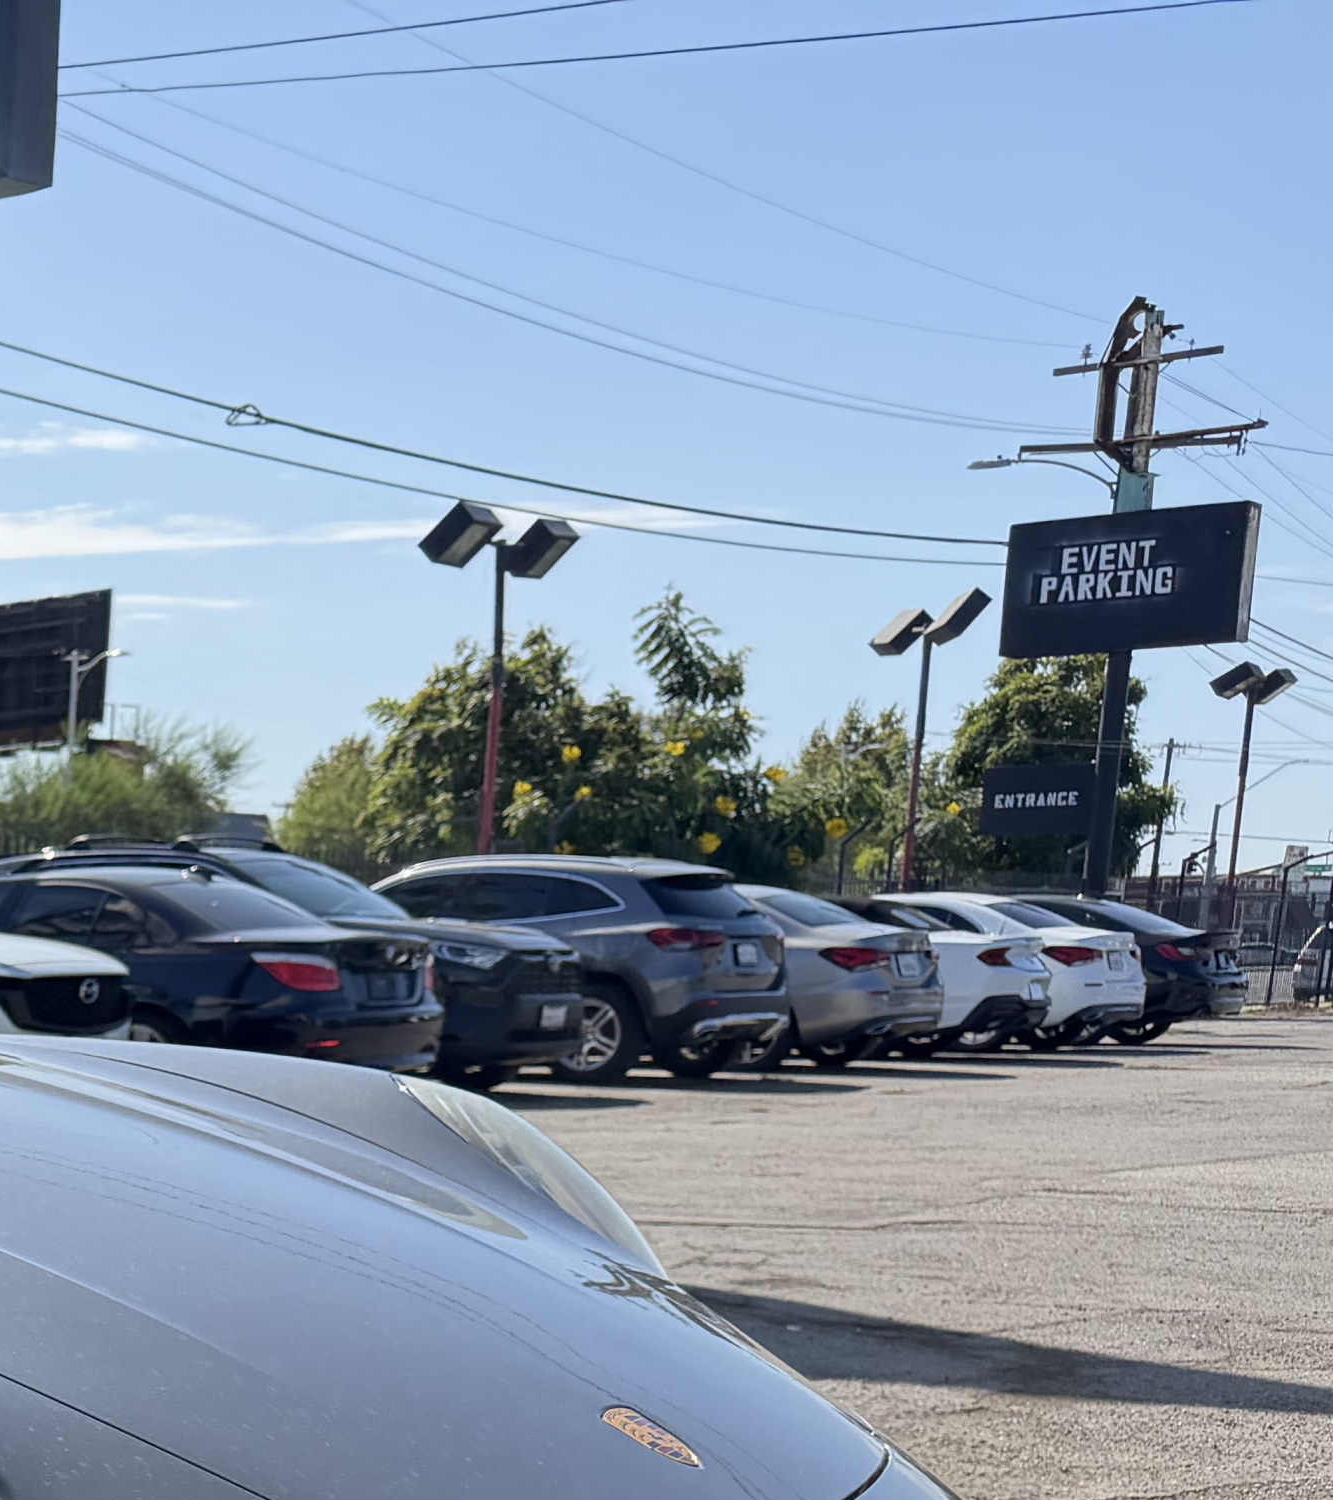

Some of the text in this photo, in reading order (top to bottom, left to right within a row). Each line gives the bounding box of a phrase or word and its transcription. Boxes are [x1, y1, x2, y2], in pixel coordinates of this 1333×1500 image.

[1060, 539, 1157, 575] EVENT
[1039, 566, 1173, 604] PARKING
[993, 790, 1079, 809] ENTRANCE
